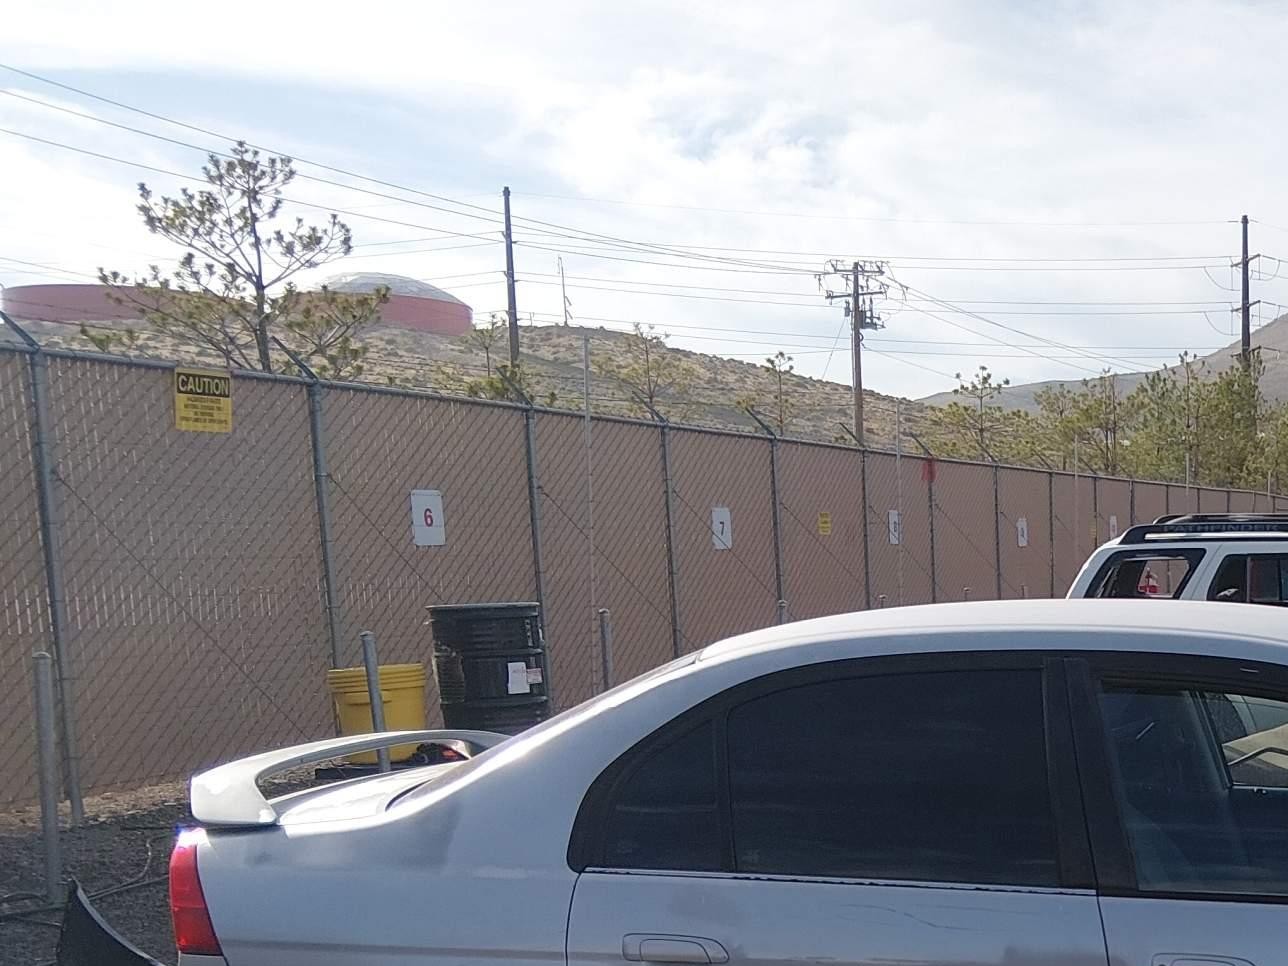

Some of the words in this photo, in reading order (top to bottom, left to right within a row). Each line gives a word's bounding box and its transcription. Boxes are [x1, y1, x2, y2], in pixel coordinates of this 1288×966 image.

[178, 375, 229, 396] CAUTION
[424, 507, 434, 528] 6
[719, 521, 725, 537] 7
